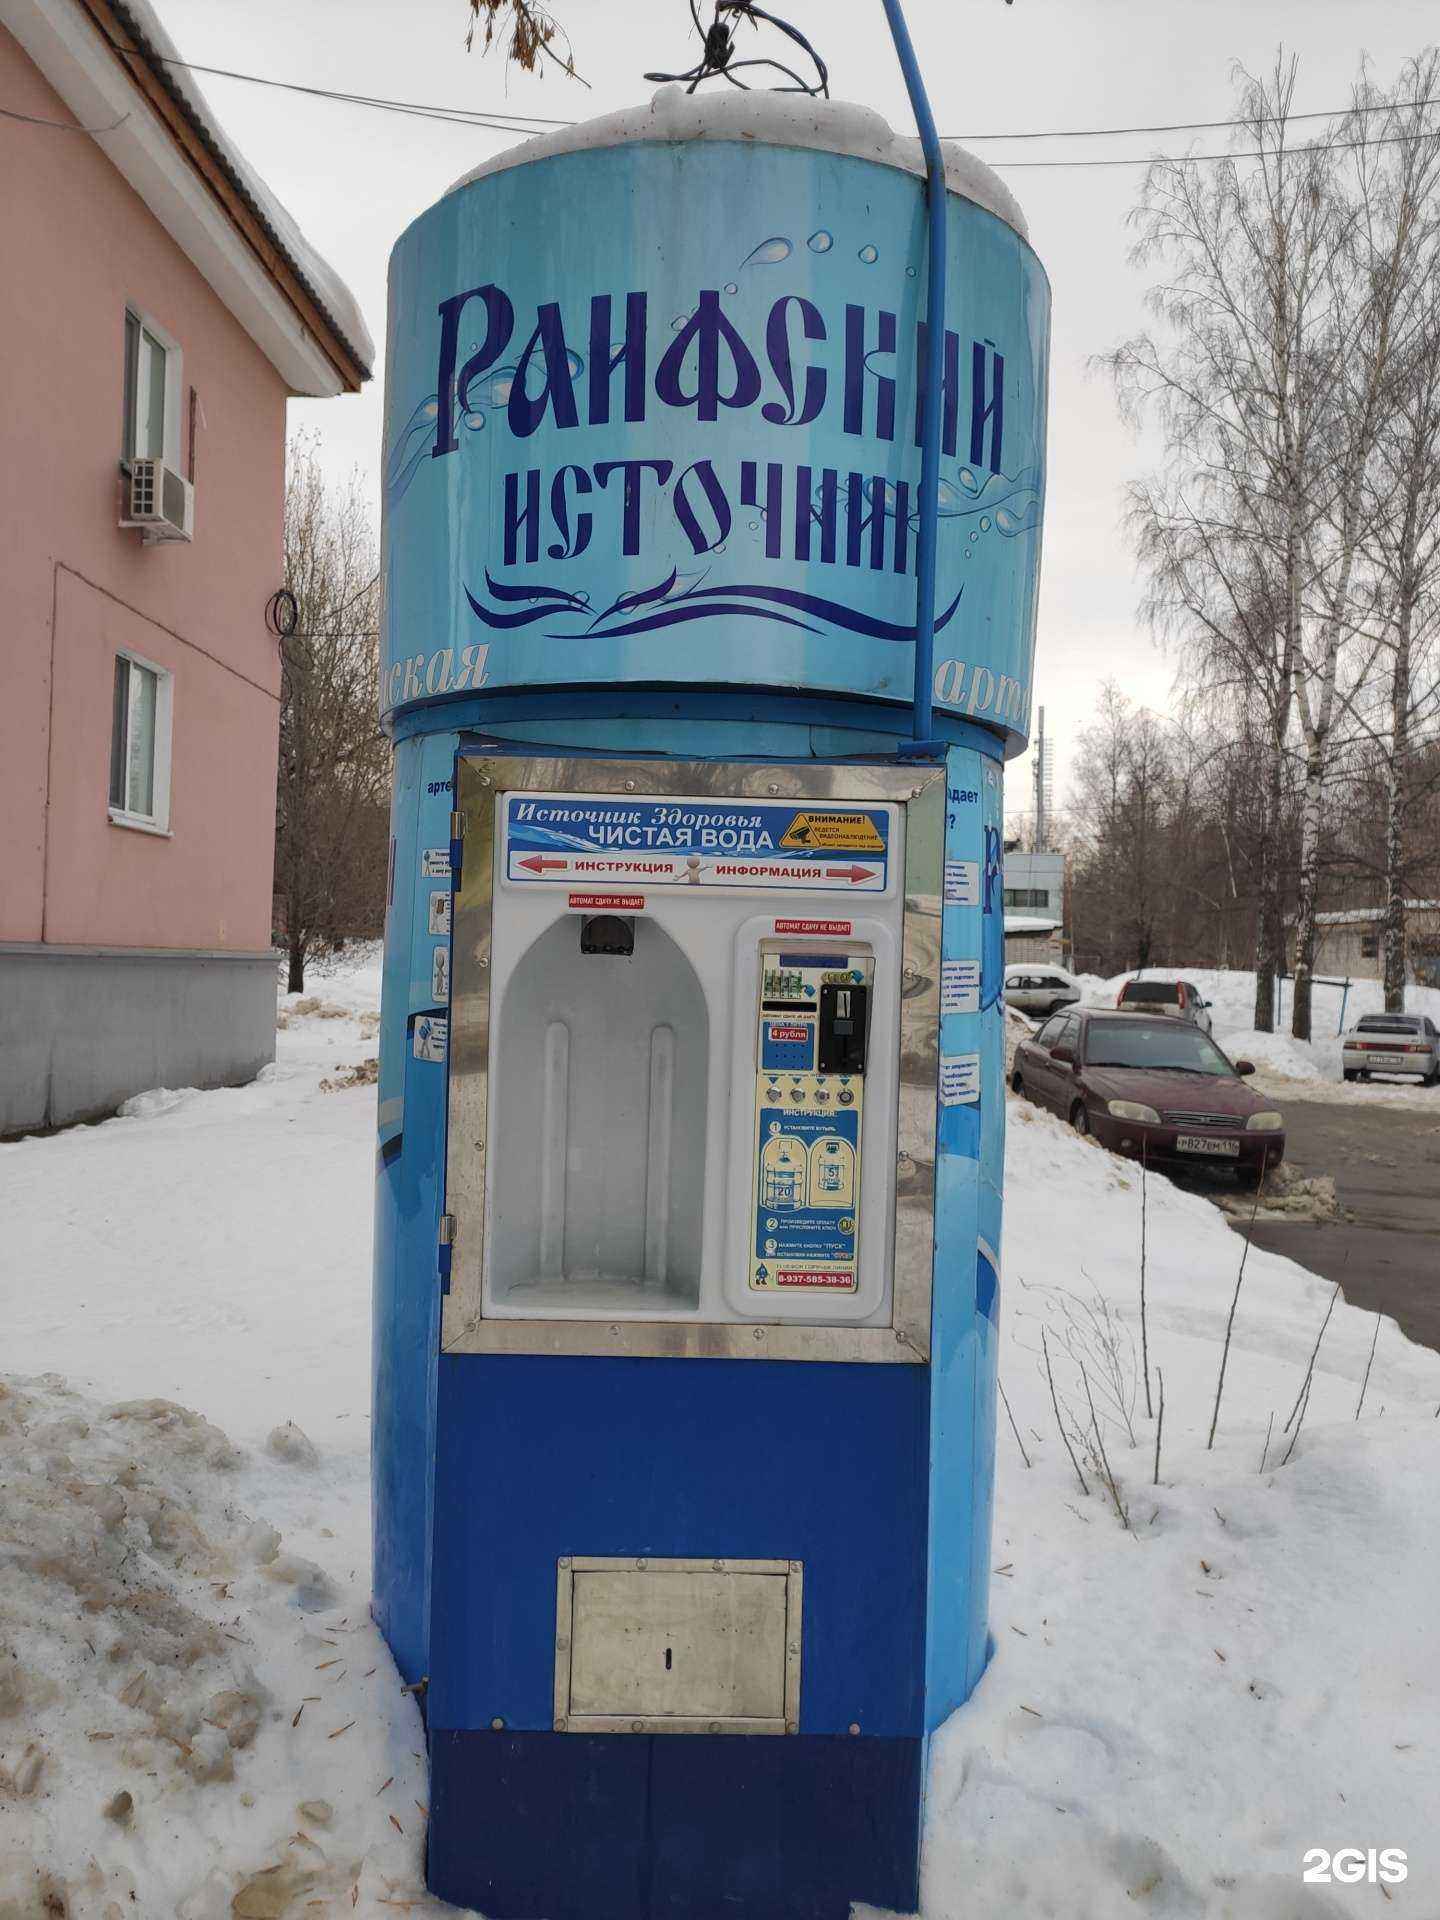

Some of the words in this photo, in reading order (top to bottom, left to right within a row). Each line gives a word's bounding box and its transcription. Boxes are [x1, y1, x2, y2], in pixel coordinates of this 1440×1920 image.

[516, 803, 642, 824] Источник
[650, 807, 763, 831] Здоровья
[808, 815, 866, 825] ВНИМАНИЕ!
[588, 825, 692, 848] ЧИСТАЯ
[701, 828, 774, 853] ВОДА
[574, 861, 675, 874] ИНСТРУКЦИЯ
[716, 866, 823, 879] ИНФОРМАЦИЯ
[569, 896, 594, 905] АВТОМАТ
[776, 921, 801, 930] АВТОМАТ
[777, 1186, 792, 1198] 20
